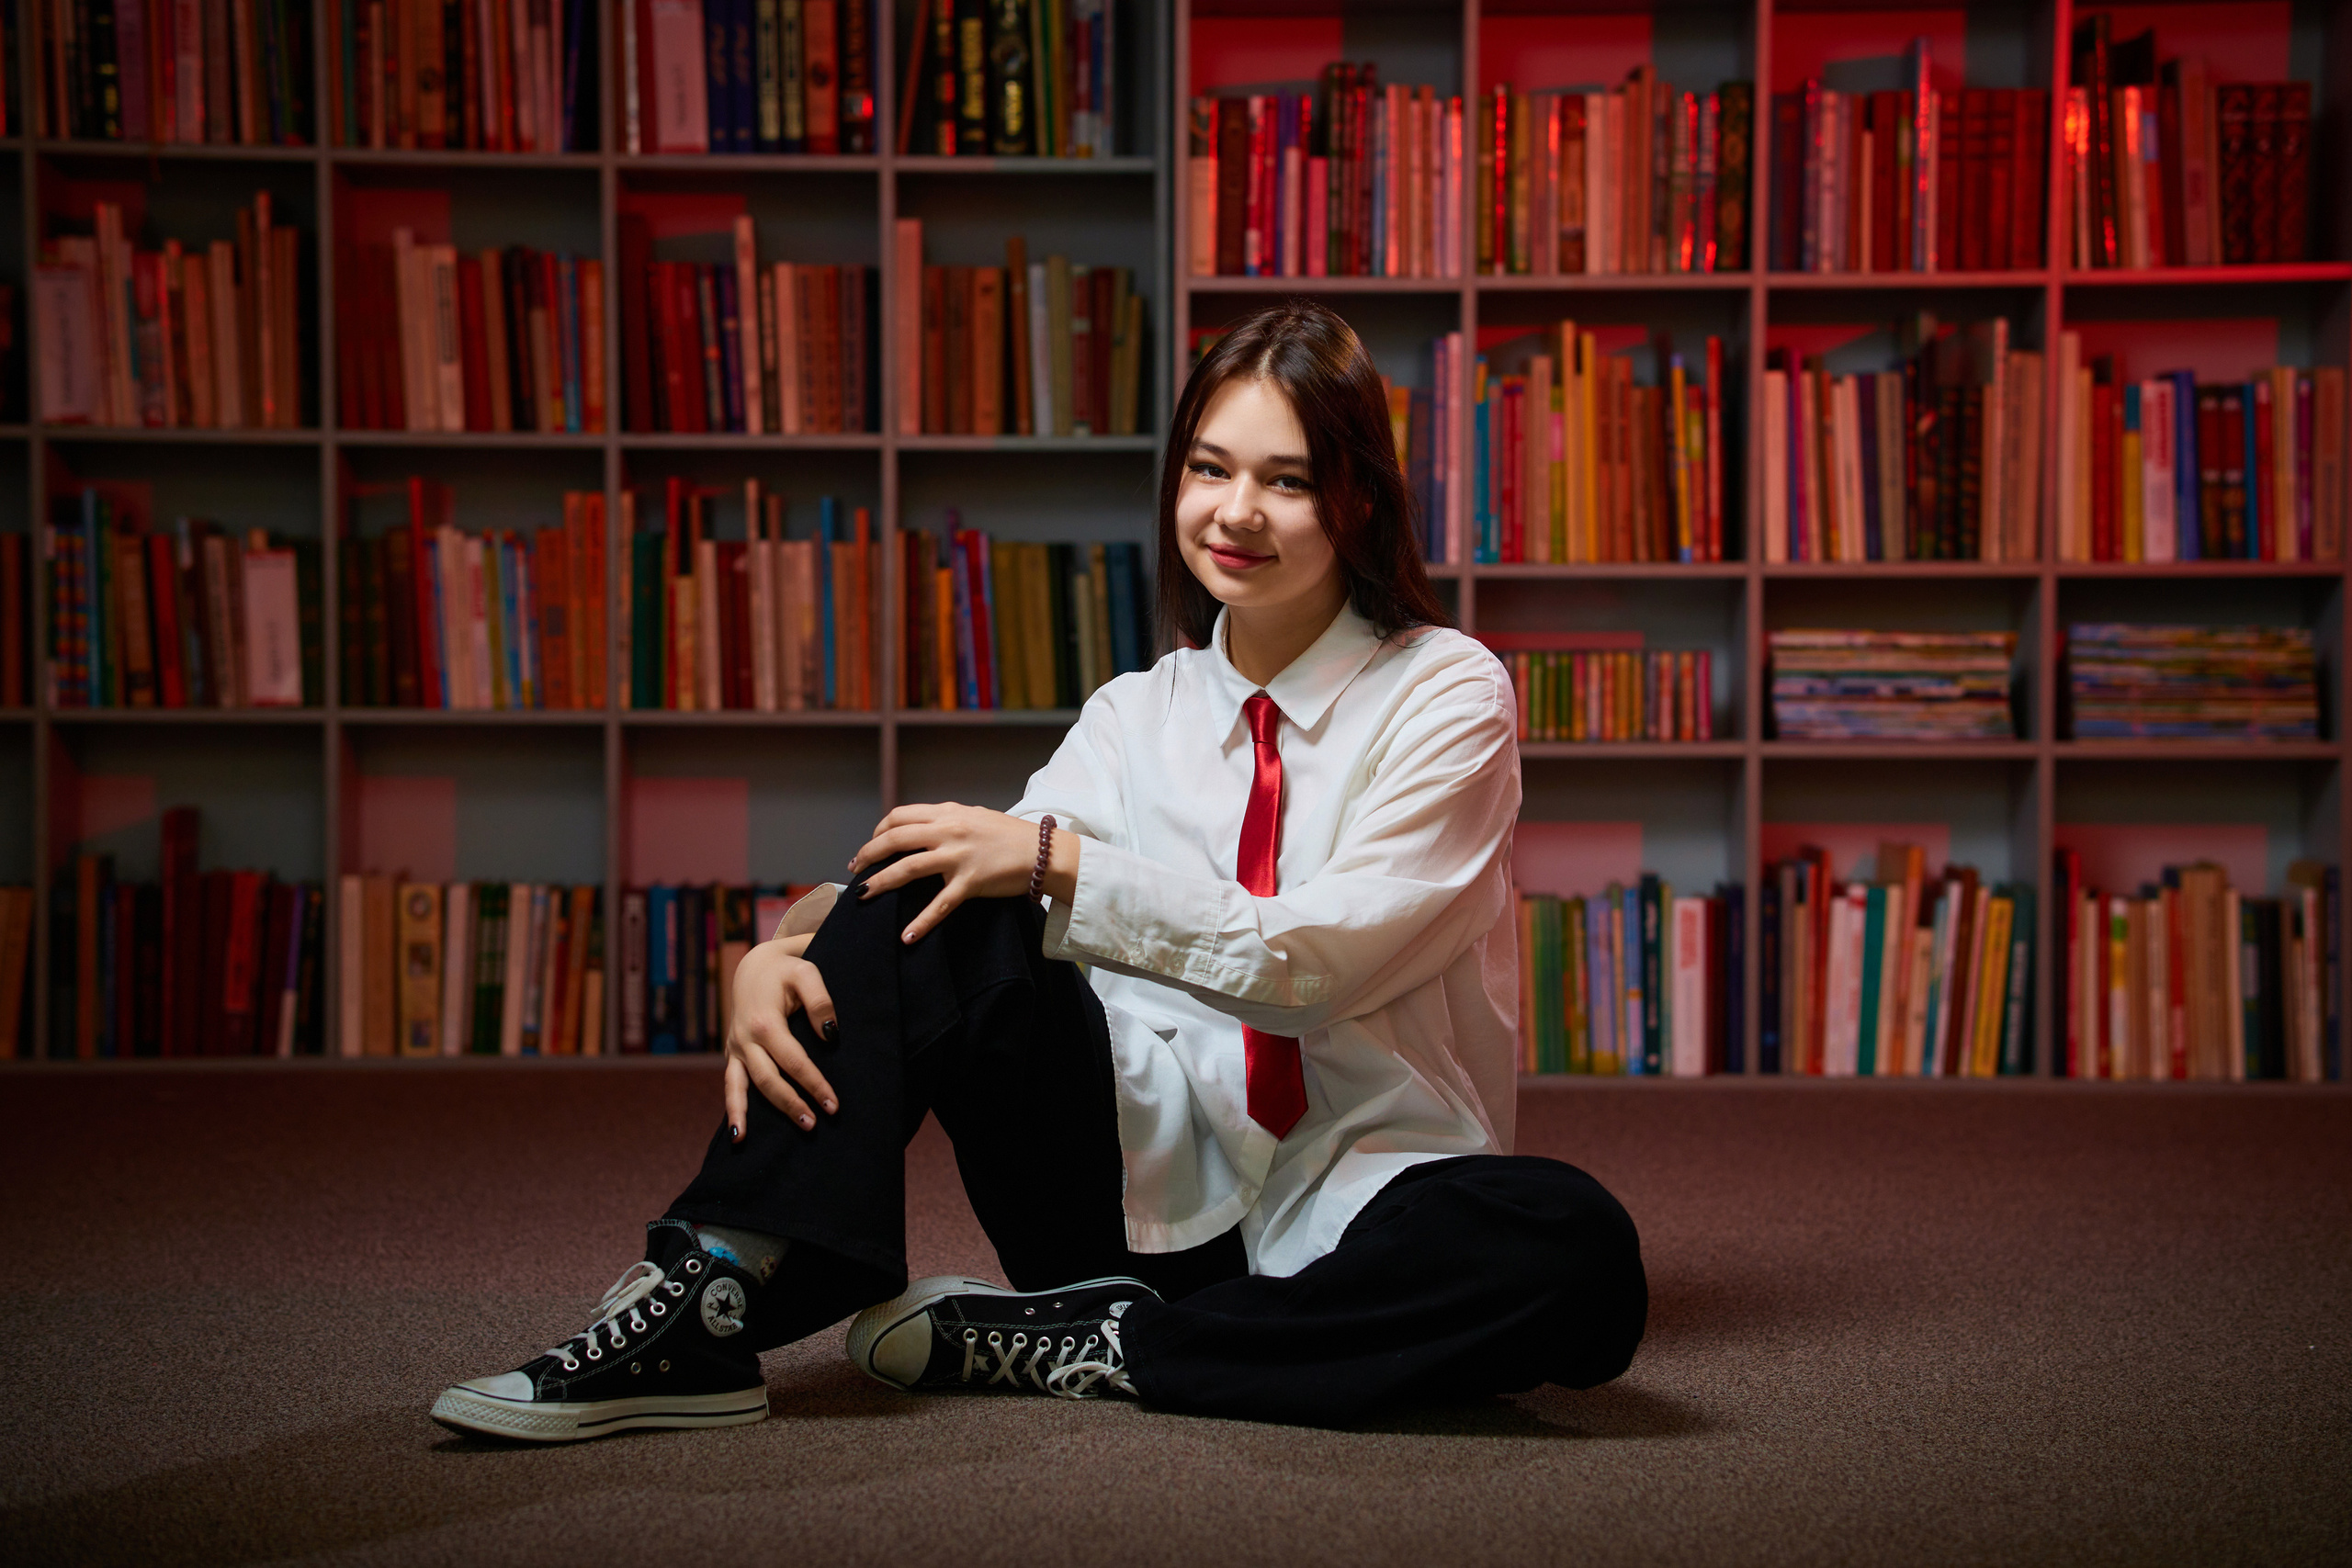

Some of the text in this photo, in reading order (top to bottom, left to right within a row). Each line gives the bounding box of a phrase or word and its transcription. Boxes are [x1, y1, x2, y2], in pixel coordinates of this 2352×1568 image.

[710, 1282, 743, 1310] CONVERSE
[707, 1315, 719, 1330] ALL
[718, 1322, 738, 1333] STAR
